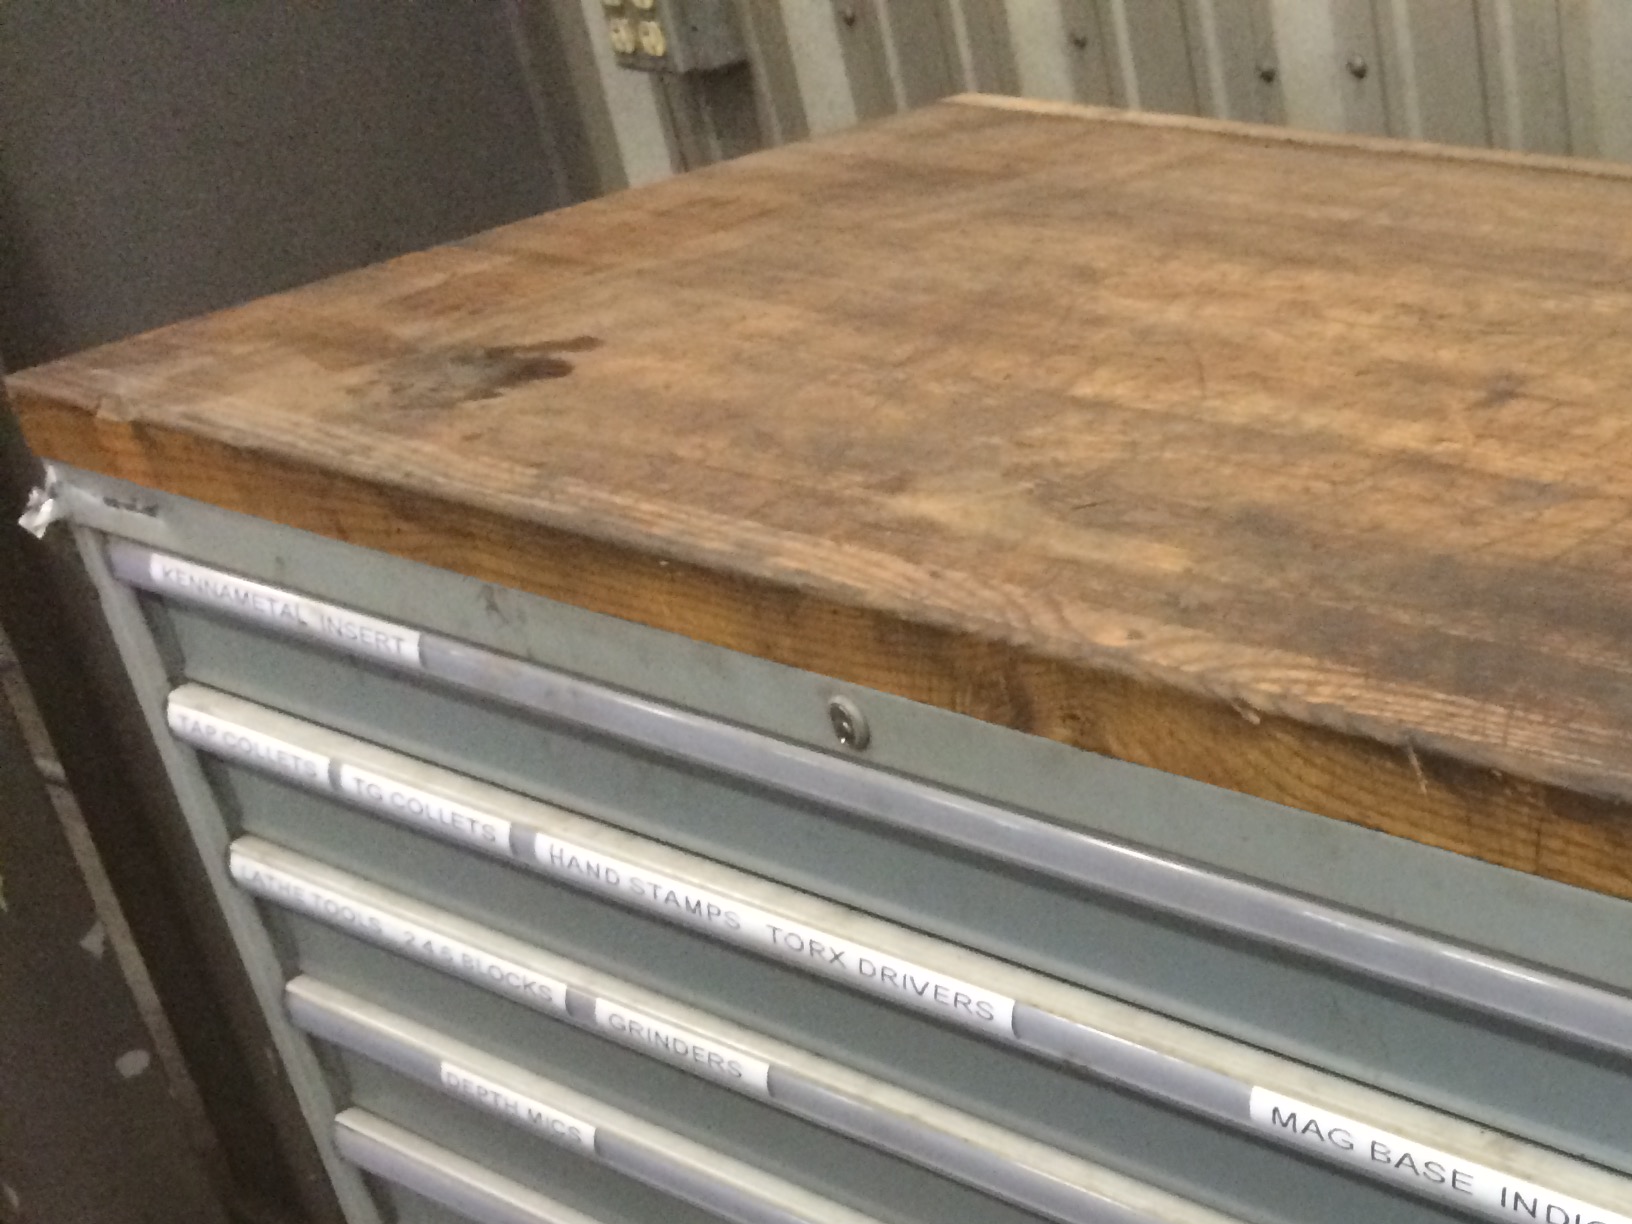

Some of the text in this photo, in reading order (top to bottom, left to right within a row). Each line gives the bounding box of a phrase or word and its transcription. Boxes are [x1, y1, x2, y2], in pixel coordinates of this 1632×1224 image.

[160, 567, 408, 652] KENNAMETAL INSERT
[179, 713, 318, 780] TAP COLLETS
[354, 777, 497, 842] TG COLLETS
[241, 863, 305, 902] LATHE
[310, 890, 384, 935] TOOLS
[462, 952, 553, 1003] BLOCKS
[549, 843, 995, 1022] HAND STAMPS TORX DRIVERS
[607, 1012, 744, 1079] GRINDERS
[447, 1070, 583, 1144] DEPTH MICS
[1271, 1106, 1354, 1151] MAG
[1370, 1140, 1474, 1195] BASE
